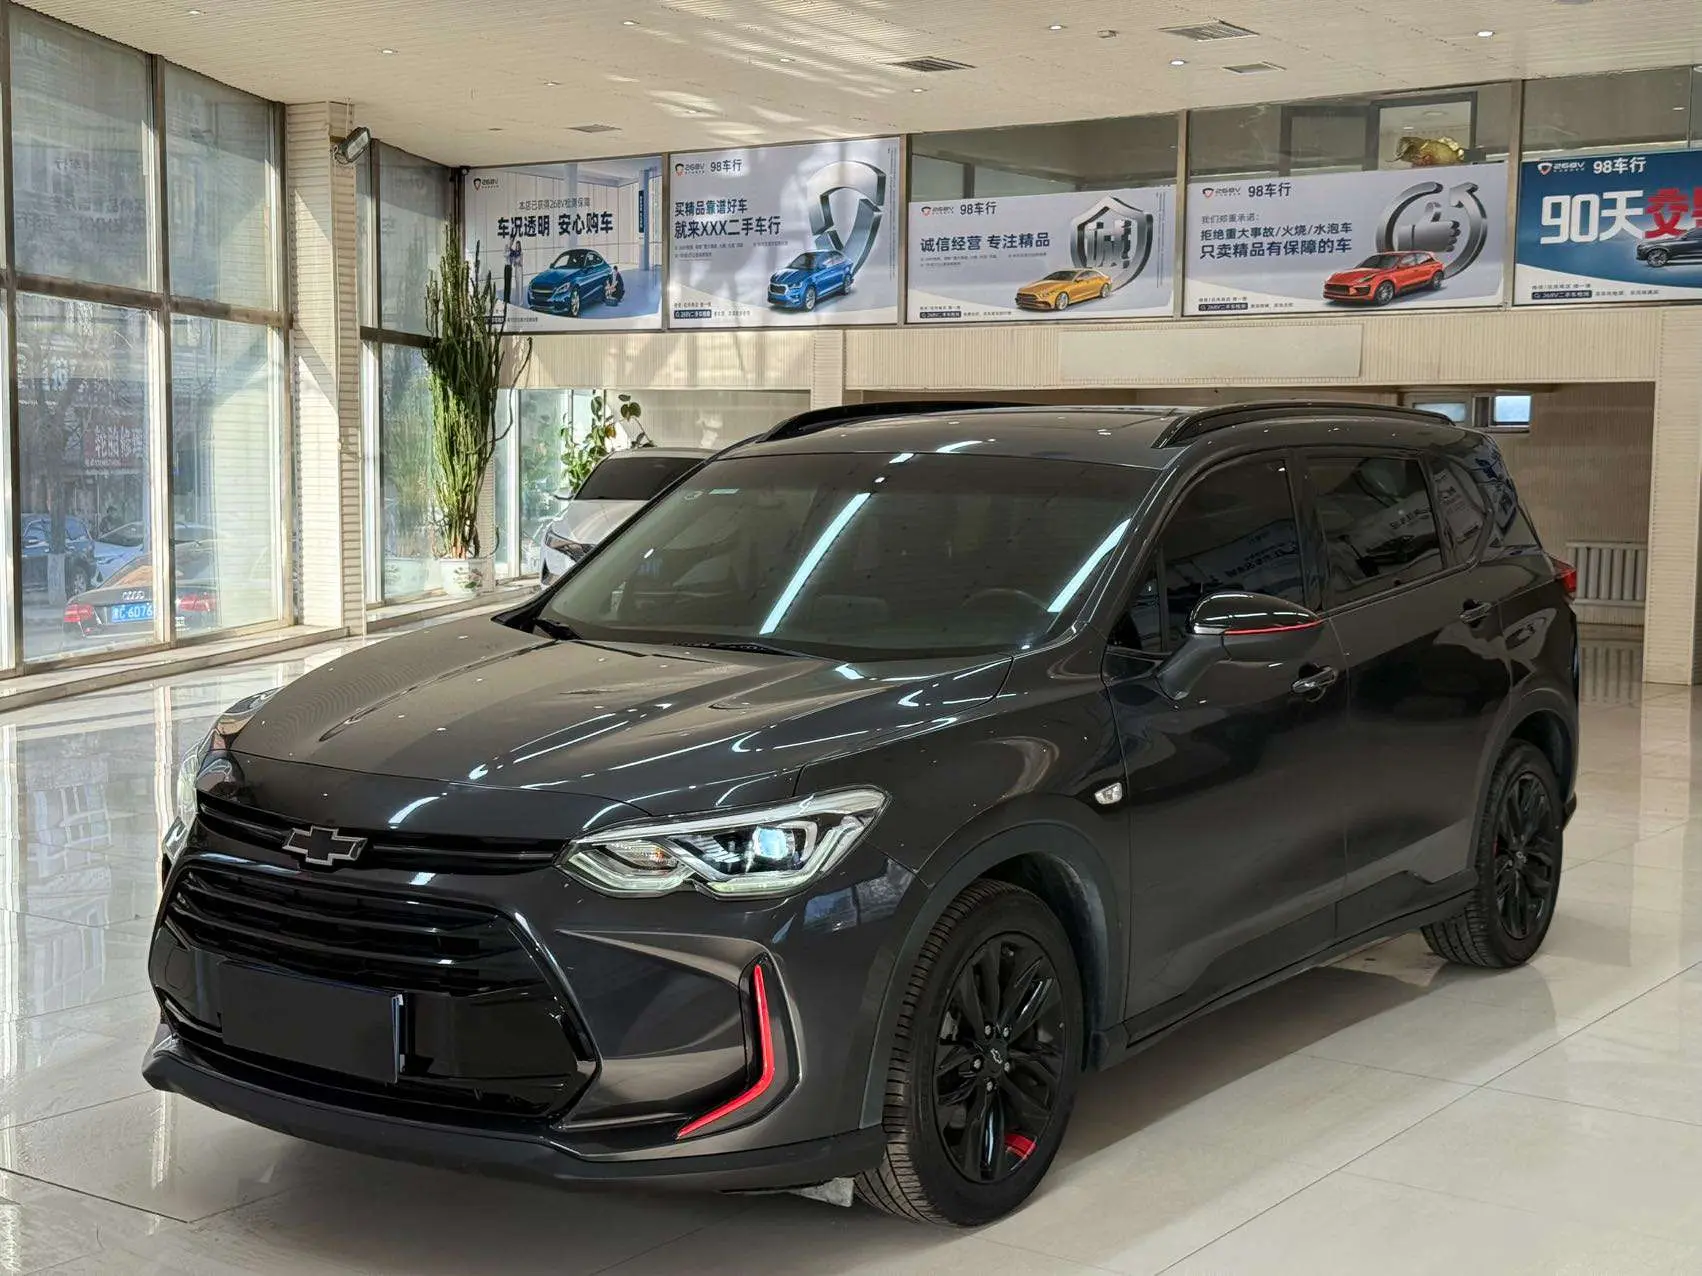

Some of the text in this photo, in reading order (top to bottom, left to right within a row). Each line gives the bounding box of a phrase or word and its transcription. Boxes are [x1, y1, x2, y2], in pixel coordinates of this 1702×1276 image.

[710, 159, 742, 172] 98车行
[1593, 157, 1647, 174] 98车行
[1248, 183, 1292, 197] 98车行
[675, 199, 748, 217] 买精品靠谱好车
[960, 201, 997, 215] 98车行
[1540, 187, 1702, 244] 90天交
[497, 215, 550, 239] 车况透明
[558, 211, 613, 235] 安心购车
[674, 216, 781, 240] 就来XXX二手车行
[1201, 222, 1353, 241] 拒绝重大事故/火烧/水泡车
[920, 232, 1050, 252] 诚信经营 专注精品
[1200, 238, 1353, 260] 只卖精品有保障的车
